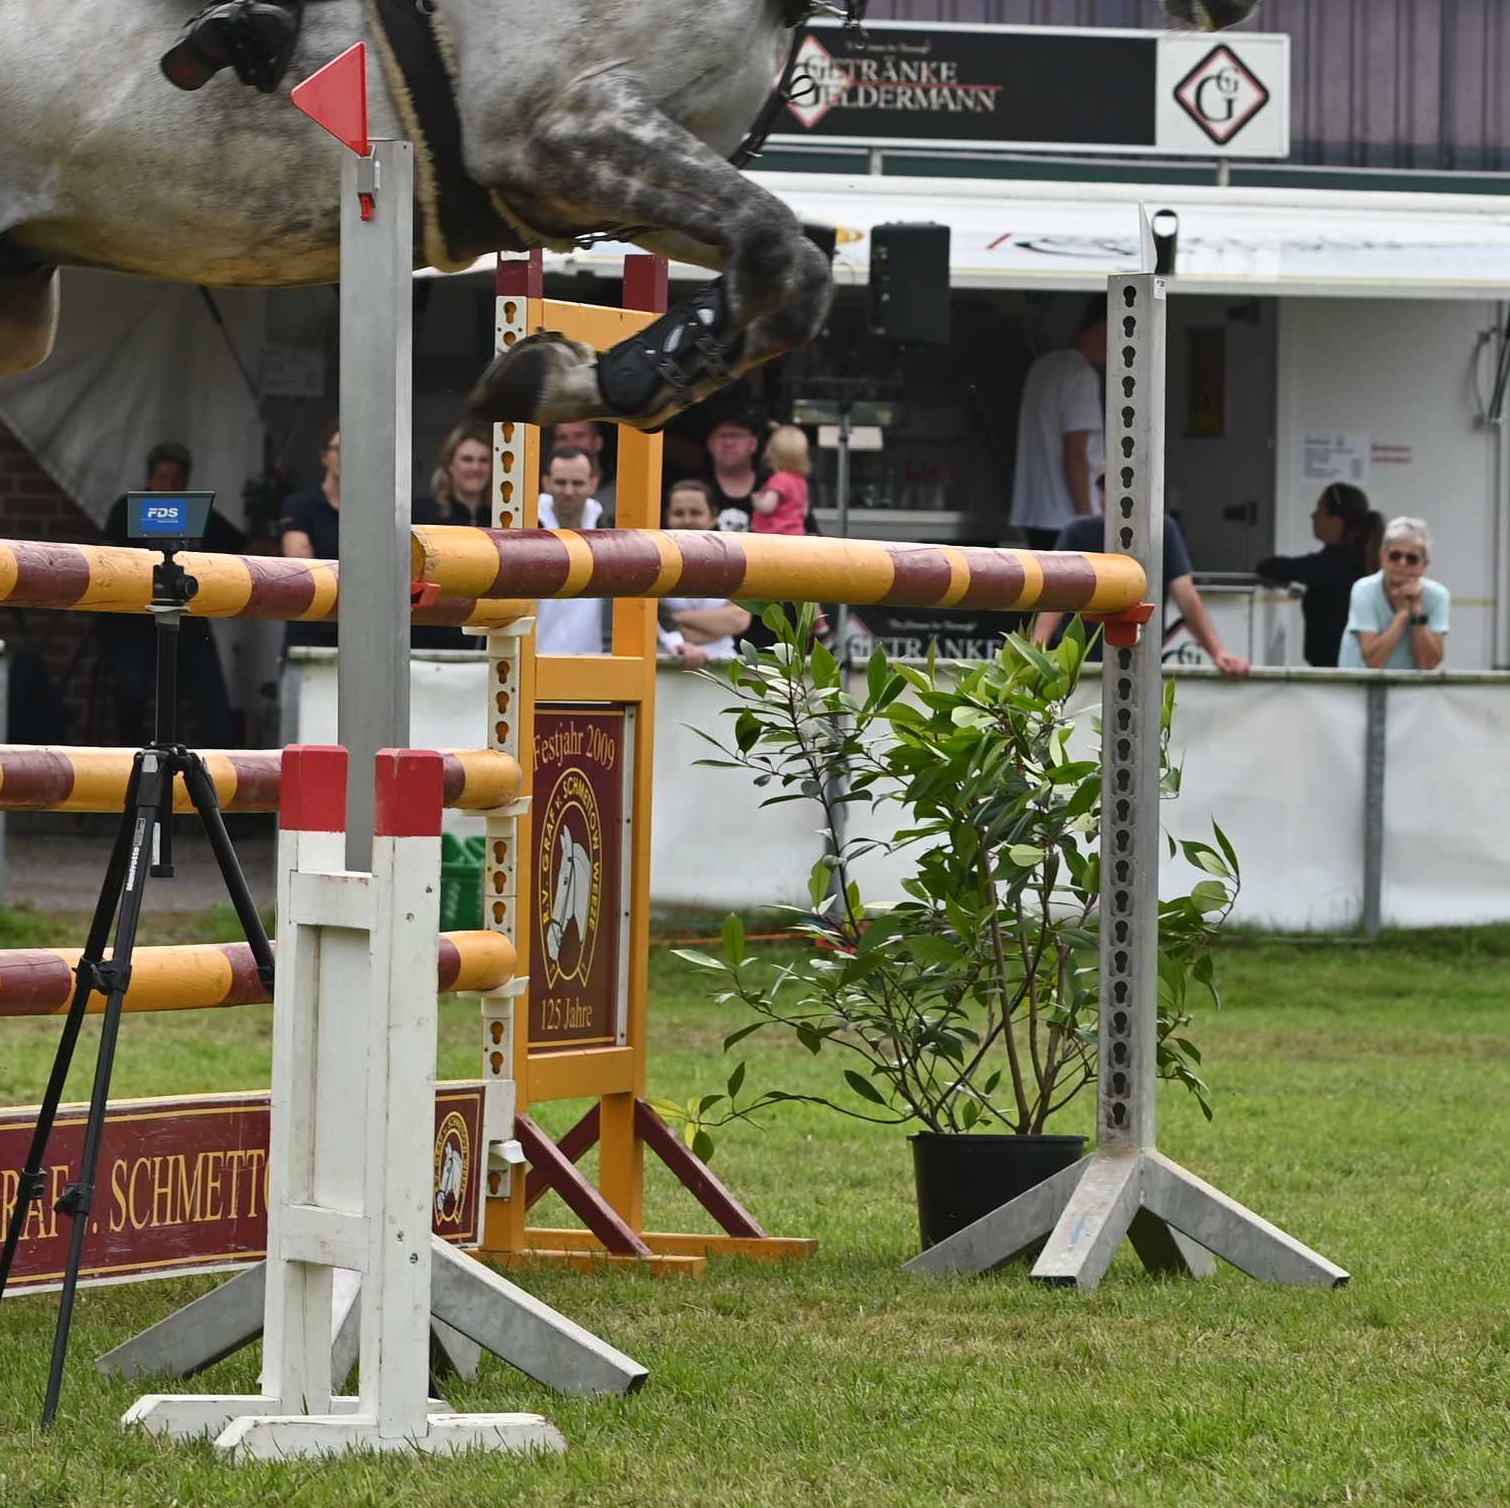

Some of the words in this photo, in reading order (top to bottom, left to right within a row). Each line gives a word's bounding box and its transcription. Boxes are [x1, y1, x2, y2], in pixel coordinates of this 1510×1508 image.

[147, 507, 179, 519] FDS
[533, 720, 584, 771] Festjahr
[586, 723, 615, 770] 2009
[540, 998, 562, 1031] 125
[563, 996, 593, 1030] Jahre
[109, 1148, 270, 1233] SCHMETT
